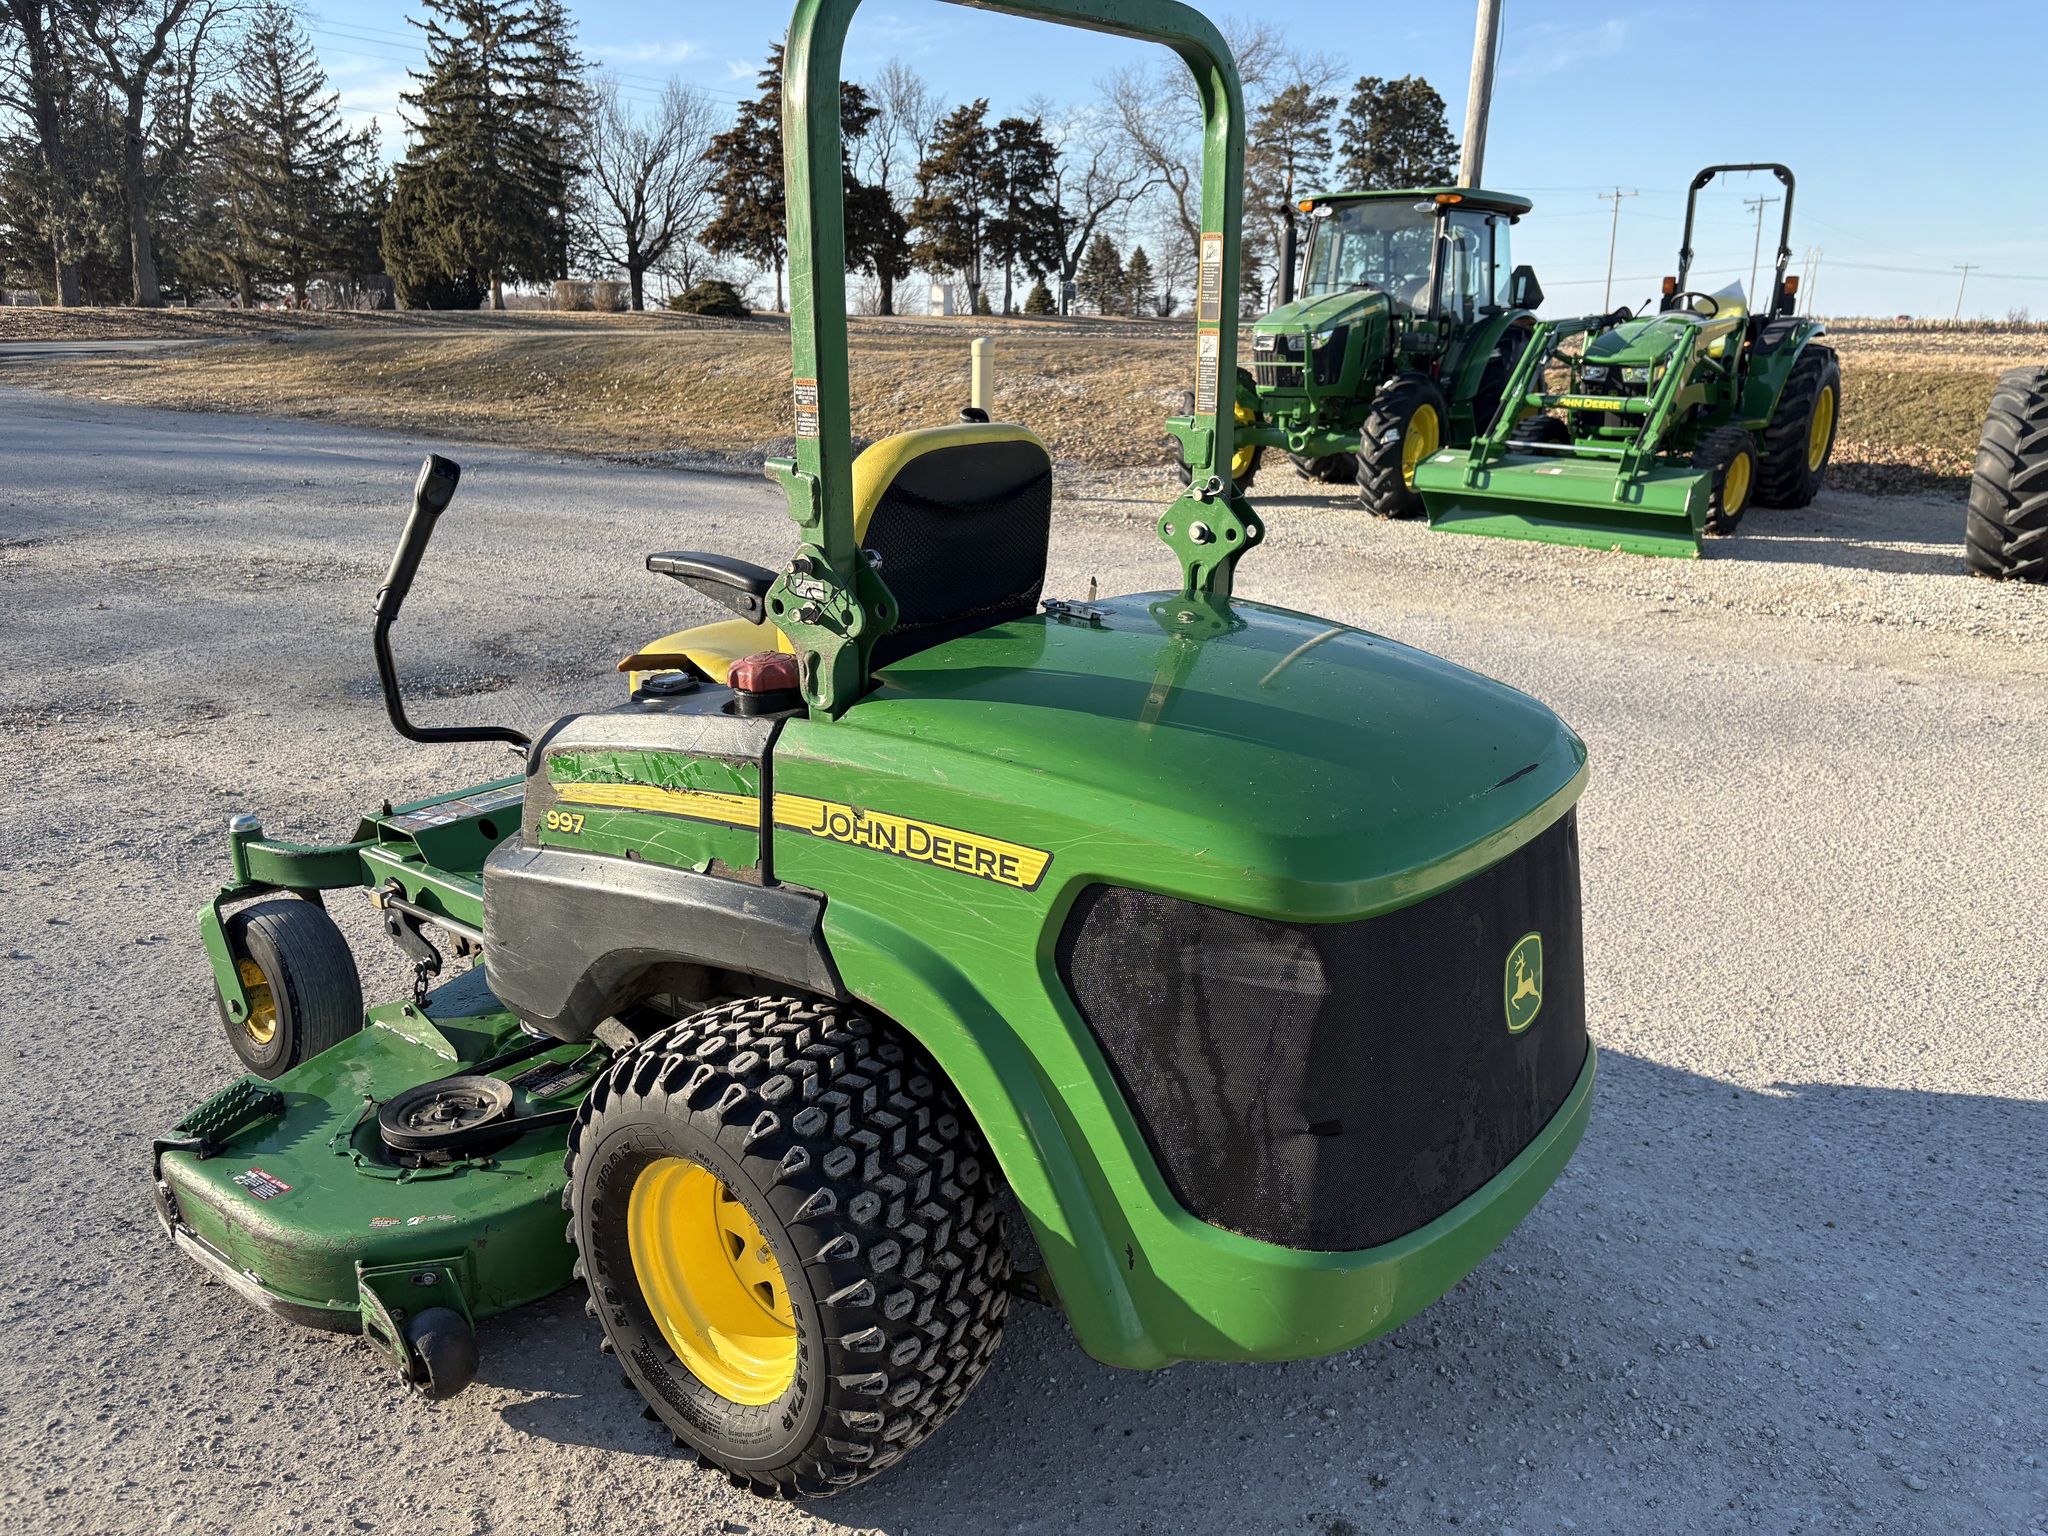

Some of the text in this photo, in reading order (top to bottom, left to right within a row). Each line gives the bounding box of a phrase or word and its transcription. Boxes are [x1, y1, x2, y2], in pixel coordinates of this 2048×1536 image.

[1584, 399, 1621, 410] DEERE
[547, 810, 585, 834] 997
[811, 804, 1021, 884] JOHN DEERE
